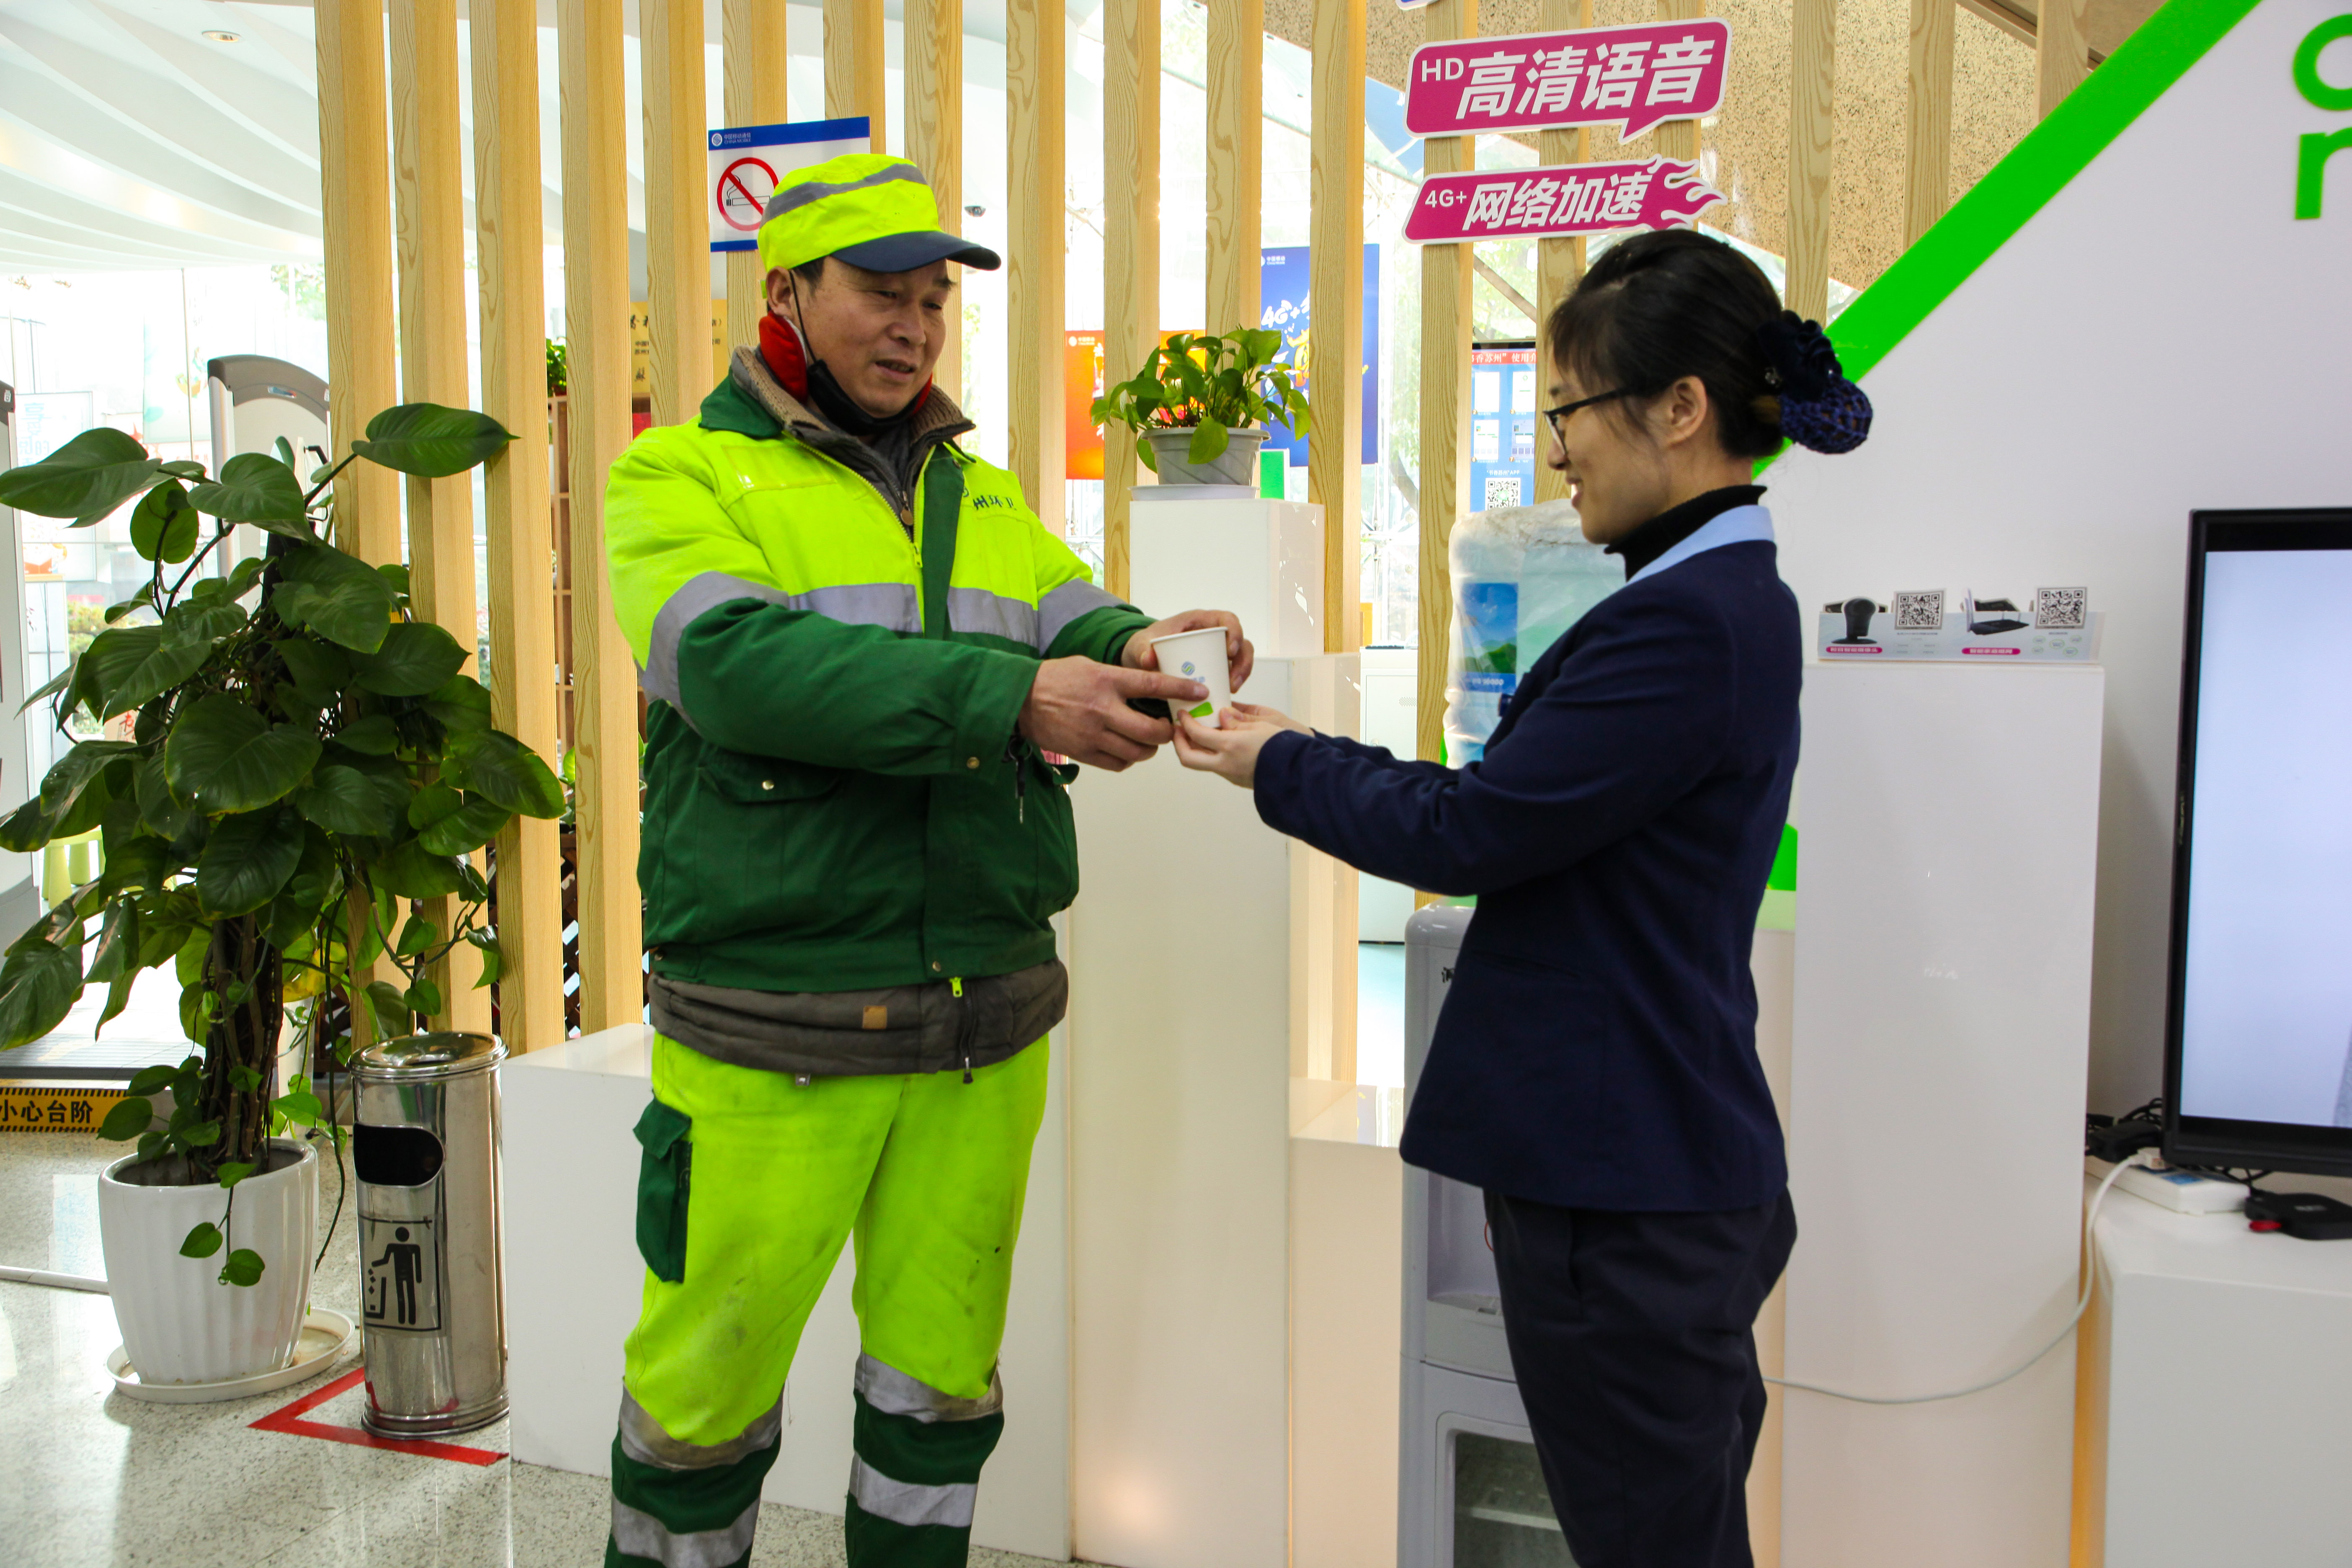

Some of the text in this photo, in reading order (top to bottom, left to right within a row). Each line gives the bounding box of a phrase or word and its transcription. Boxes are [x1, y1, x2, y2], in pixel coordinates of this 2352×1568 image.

[1421, 34, 1715, 120] HD 高清语音
[1425, 171, 1653, 231] 4G+ 网络加速
[0, 1099, 93, 1124] 小心台阶
